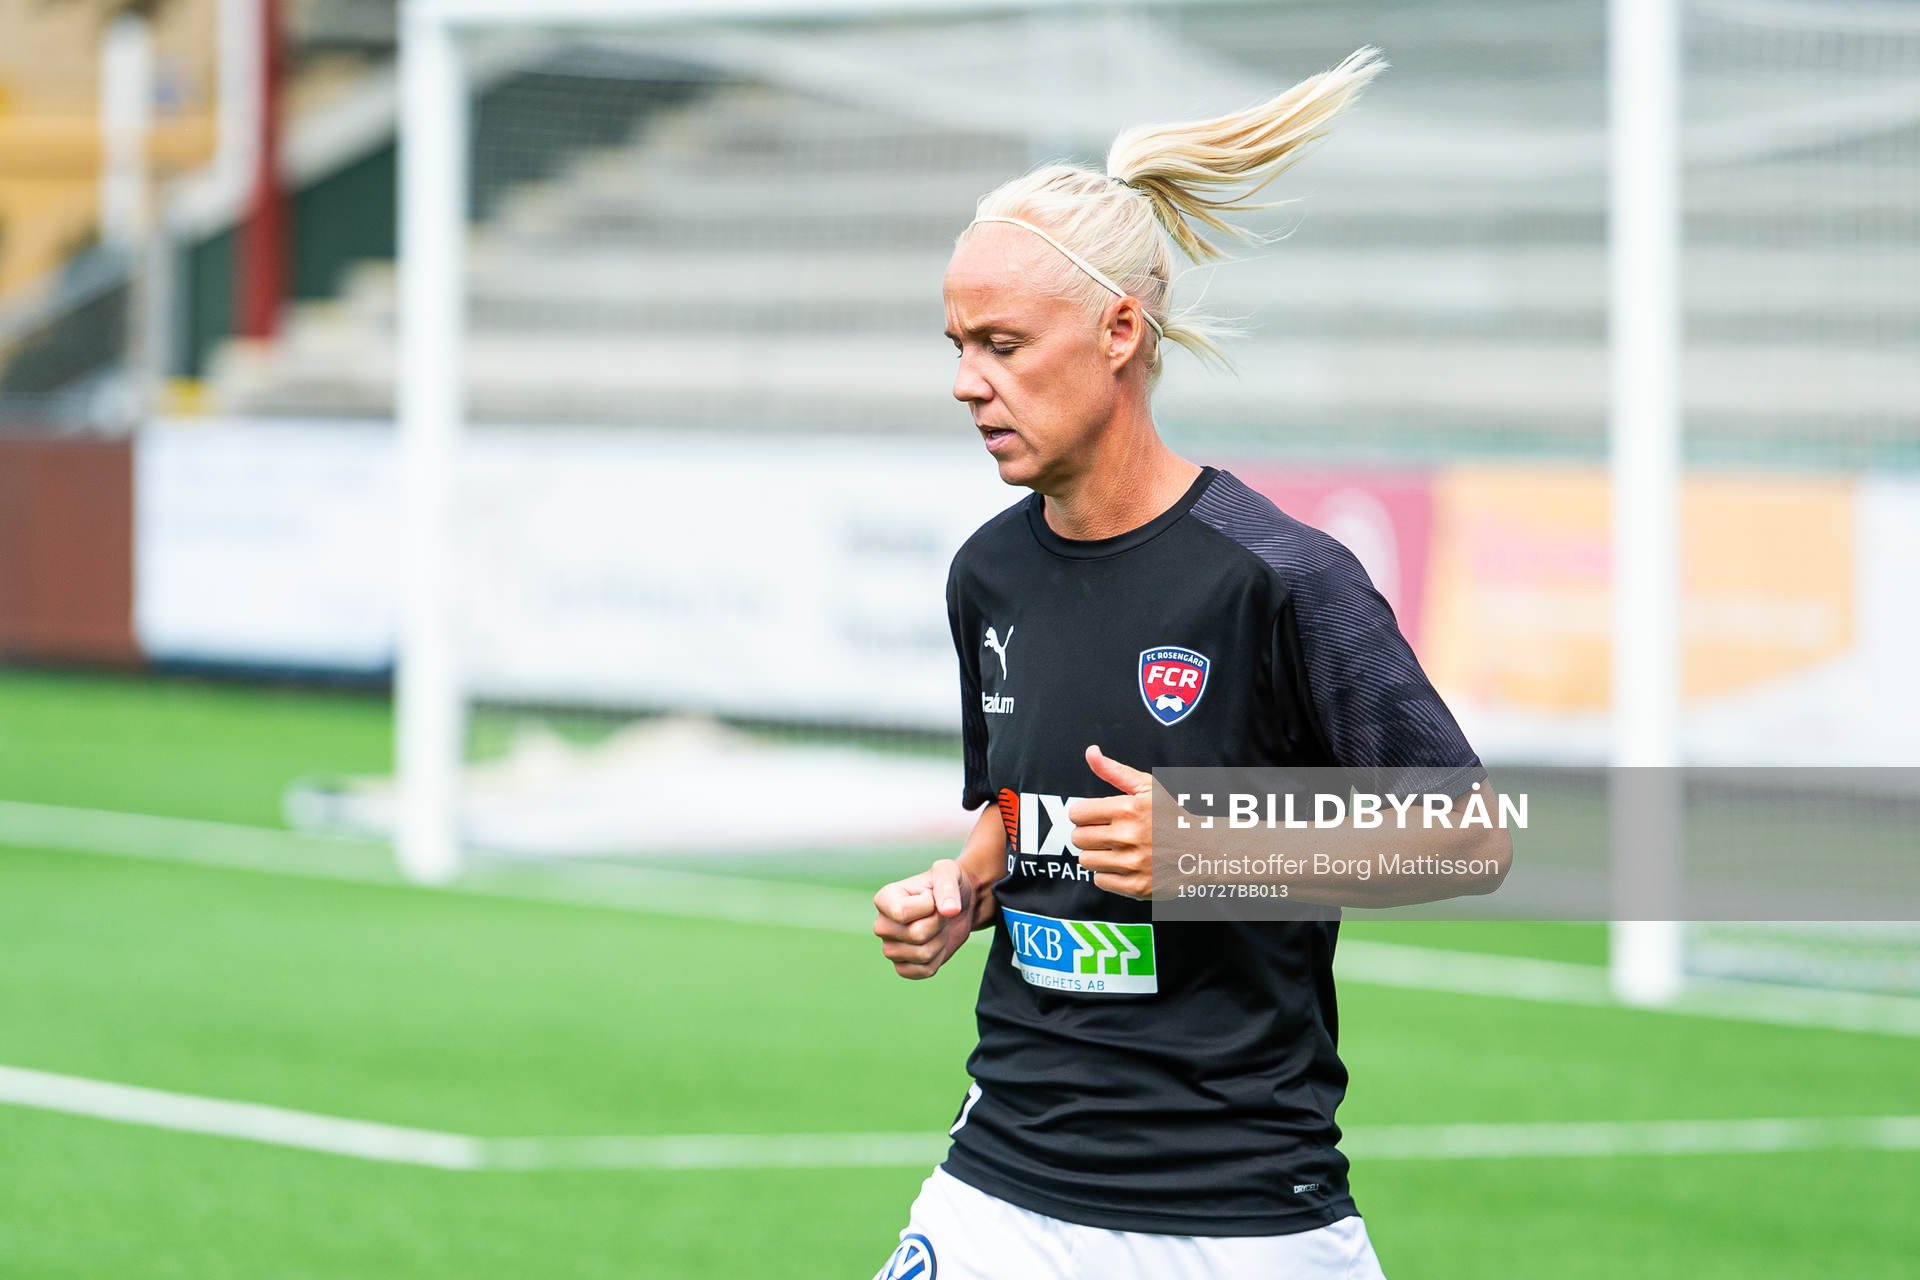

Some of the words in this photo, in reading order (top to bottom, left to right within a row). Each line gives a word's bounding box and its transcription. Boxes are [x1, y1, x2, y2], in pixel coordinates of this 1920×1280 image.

[1146, 653, 1156, 661] FC
[1157, 651, 1204, 667] ROSENGÅRD
[1147, 665, 1199, 689] FCR
[1020, 860, 1096, 882] IT-PAR
[1022, 968, 1082, 990] ASTIGHETS
[1087, 980, 1105, 991] AB
